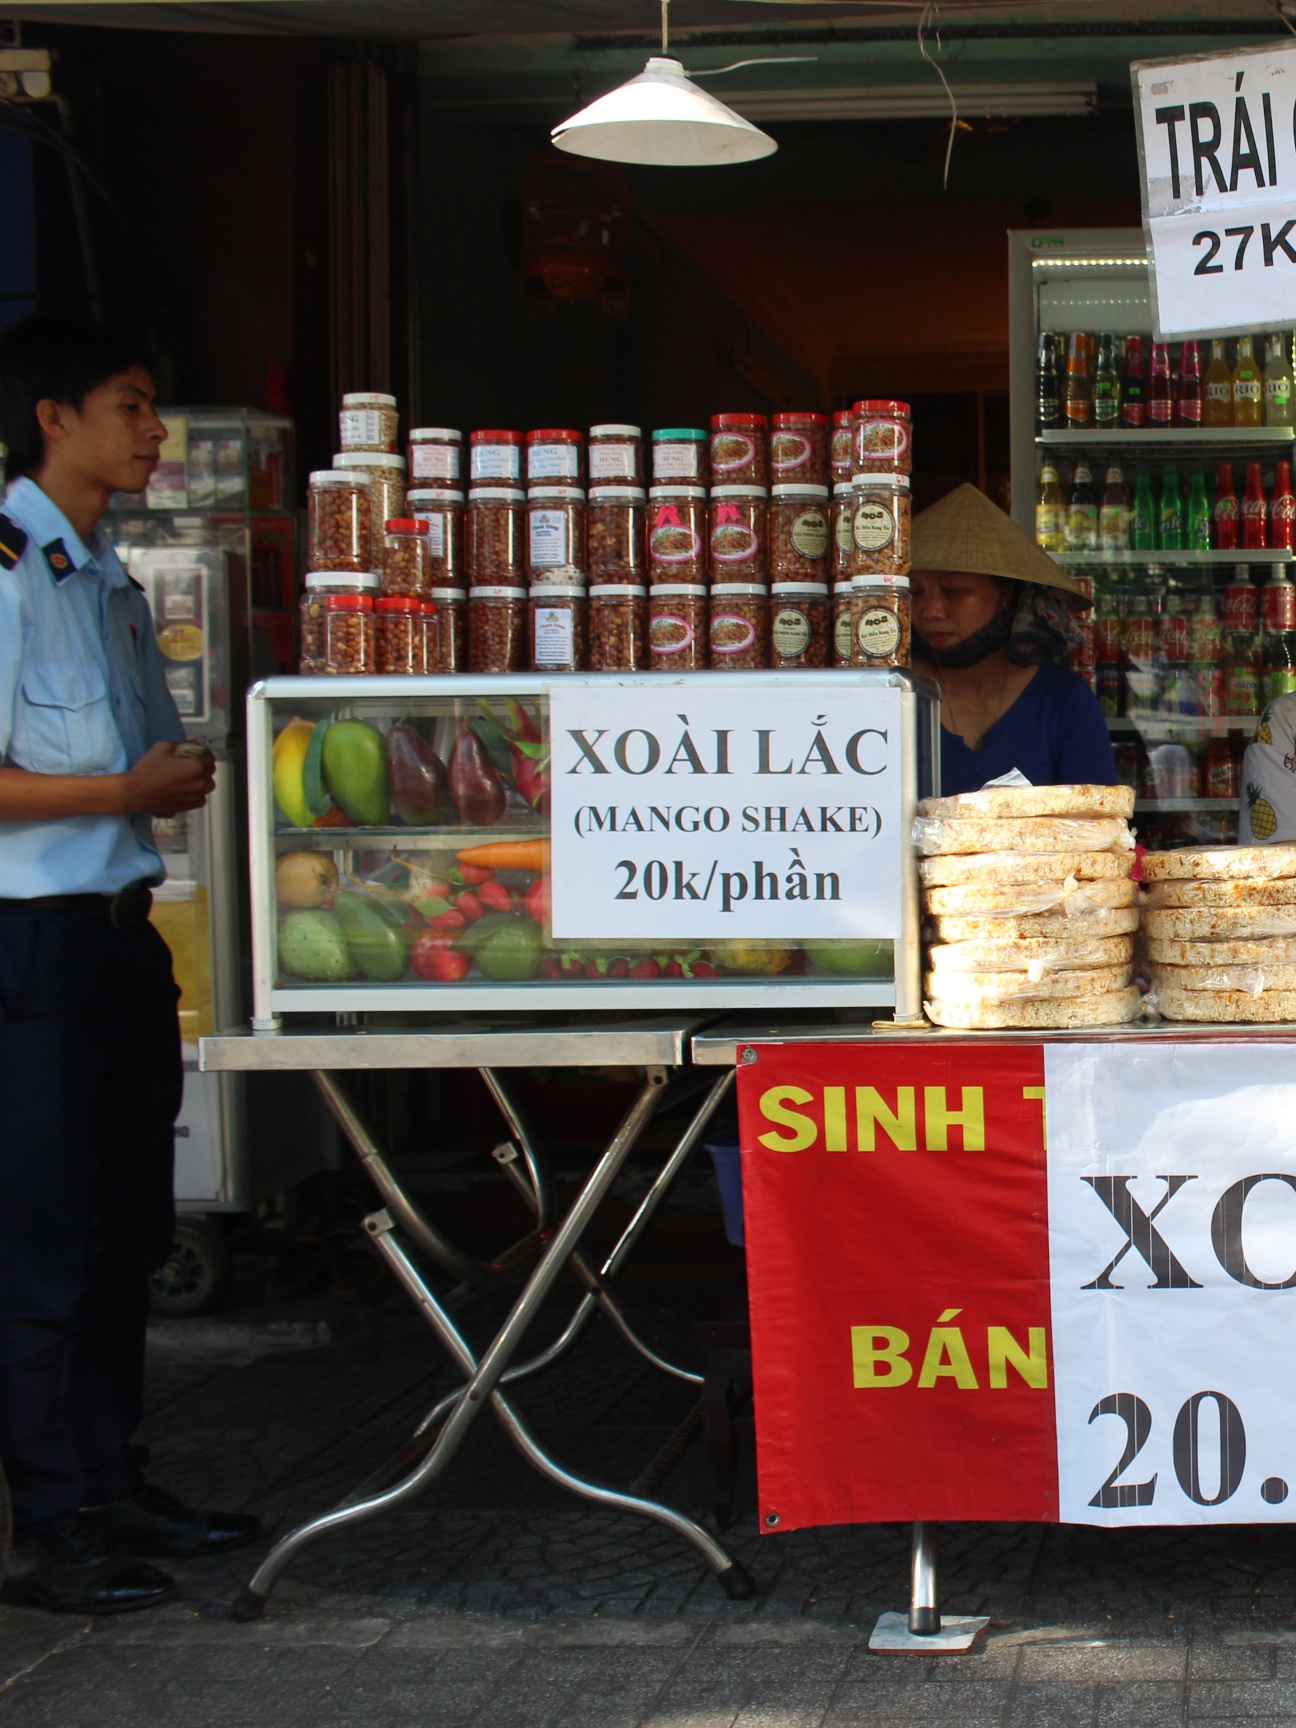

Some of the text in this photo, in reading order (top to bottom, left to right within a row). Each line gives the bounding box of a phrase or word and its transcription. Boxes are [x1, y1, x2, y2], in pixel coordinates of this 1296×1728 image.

[1155, 71, 1278, 200] TRÁI
[565, 714, 889, 776] XOÀI LẮC
[574, 805, 883, 840] (MANGO SHAKE)
[613, 847, 842, 913] 20k/phần
[757, 1085, 986, 1153] SINH
[850, 1308, 1048, 1390] BÁN
